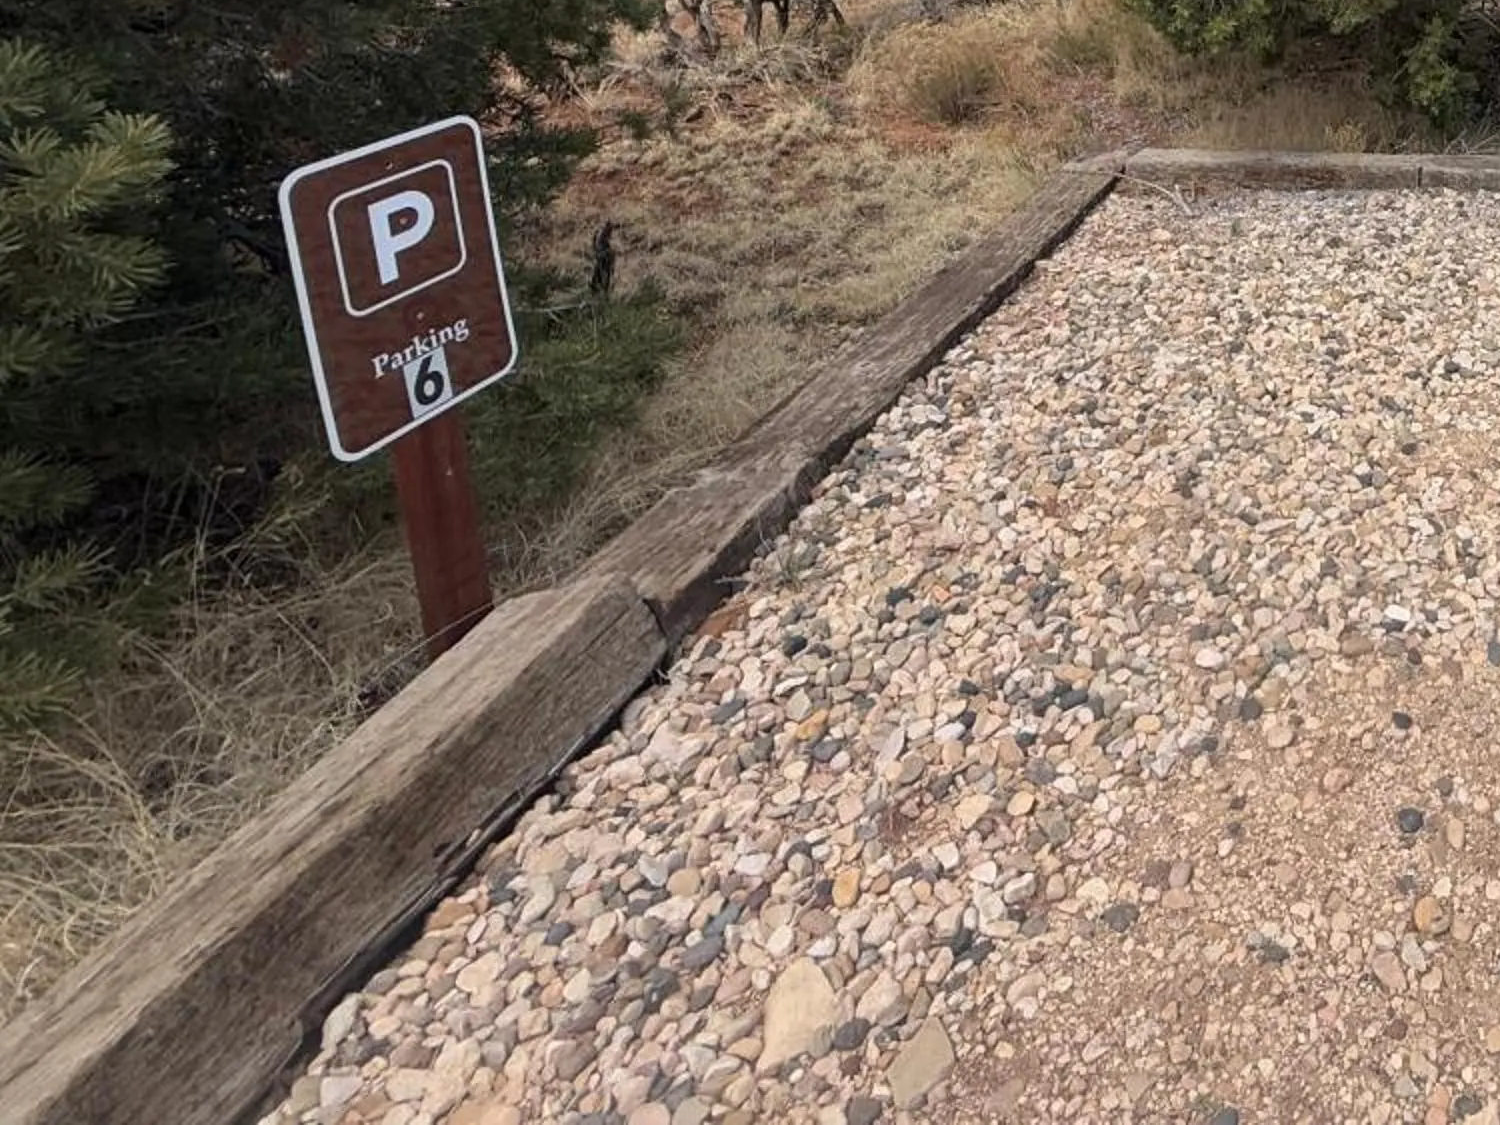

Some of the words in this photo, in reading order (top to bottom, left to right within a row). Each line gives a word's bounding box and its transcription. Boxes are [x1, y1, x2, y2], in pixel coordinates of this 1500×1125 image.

[367, 190, 435, 285] P
[372, 318, 470, 379] Parking
[414, 356, 445, 406] 6
